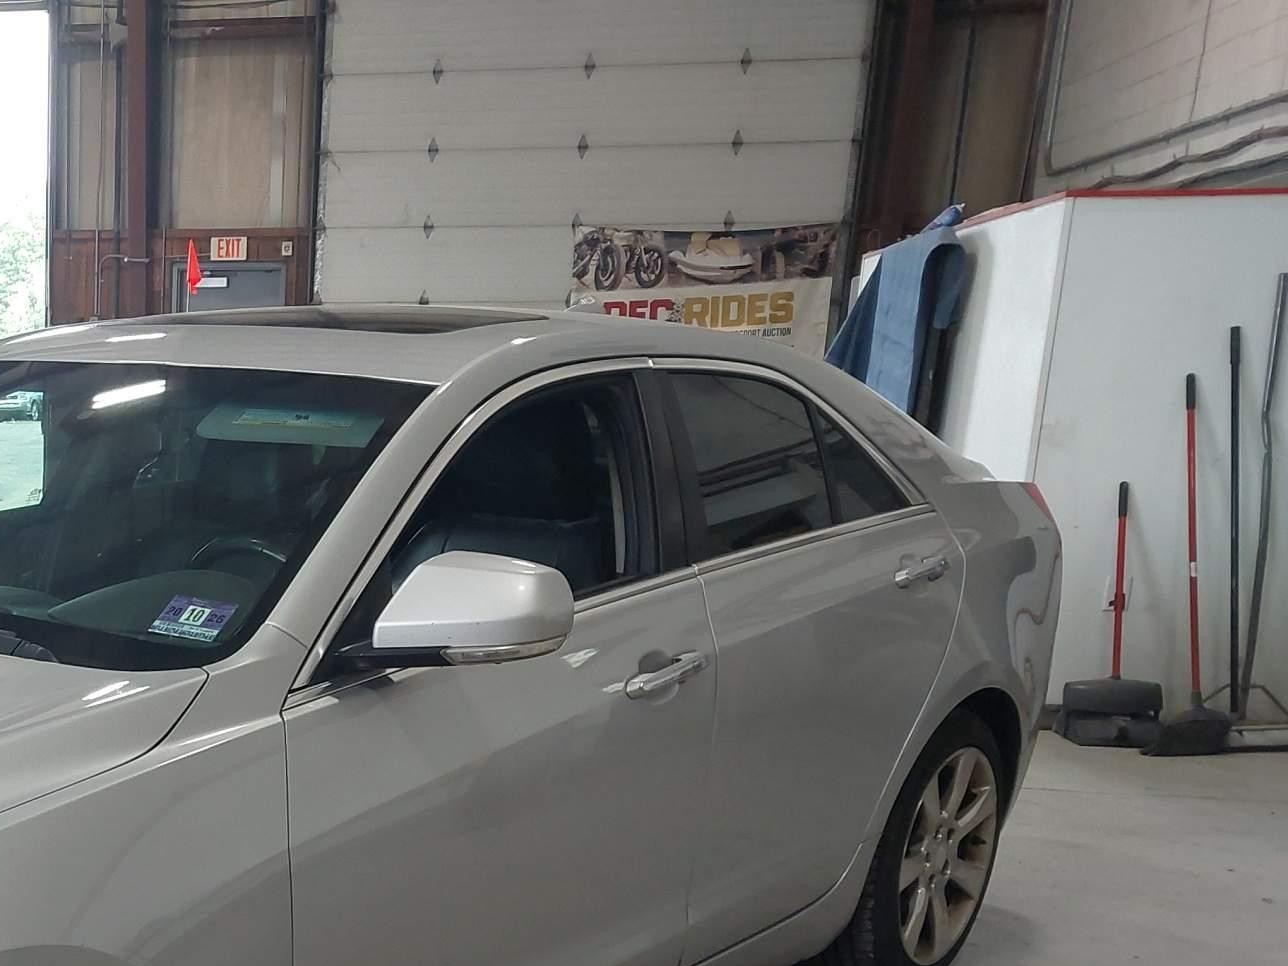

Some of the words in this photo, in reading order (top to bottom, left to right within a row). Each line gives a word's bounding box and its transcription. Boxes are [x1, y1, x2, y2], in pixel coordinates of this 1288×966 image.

[217, 238, 242, 258] EXIT
[682, 291, 795, 328] RIDES
[761, 327, 792, 337] AUCTION
[184, 608, 206, 623] 10
